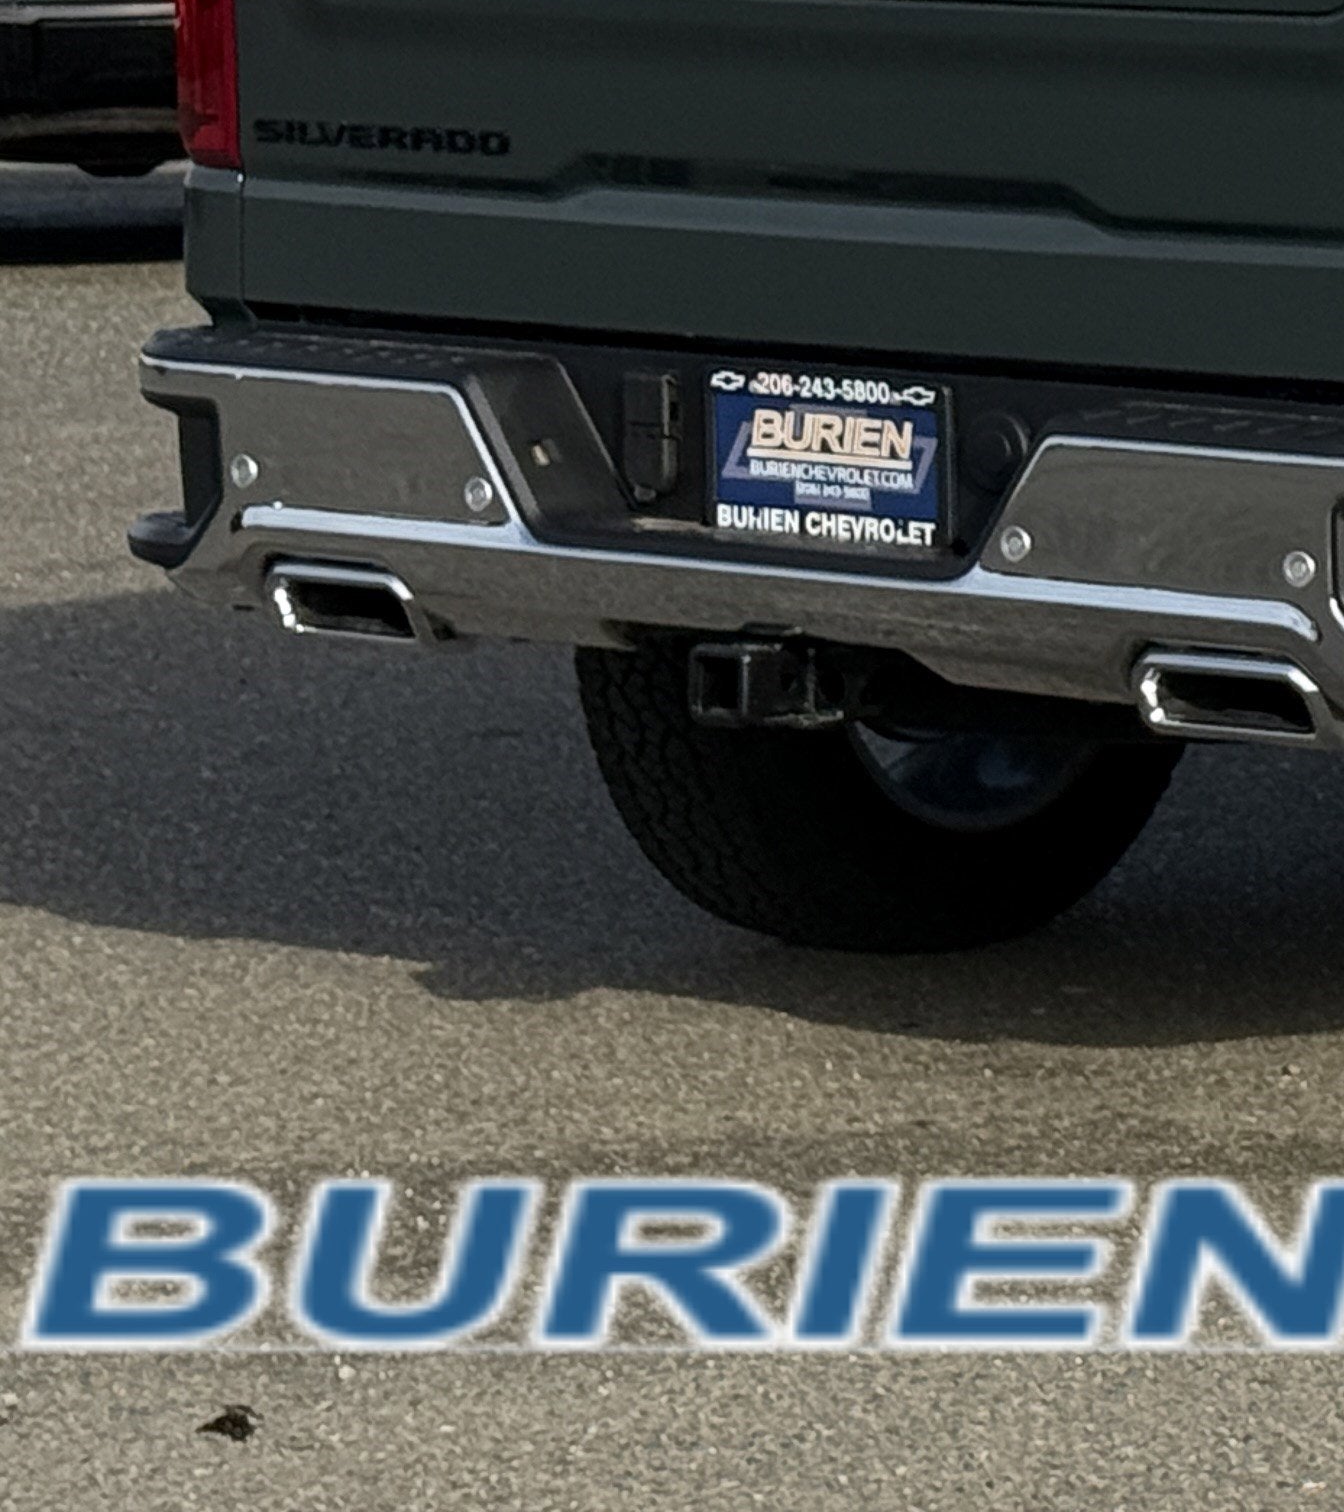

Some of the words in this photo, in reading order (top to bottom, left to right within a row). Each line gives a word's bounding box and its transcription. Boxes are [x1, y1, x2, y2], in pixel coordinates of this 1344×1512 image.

[253, 118, 511, 157] SILVERADO
[757, 371, 890, 405] 206-243-5800
[751, 409, 914, 460] BURIEN
[749, 459, 914, 489] BURIENCHEVROLET.COM
[717, 503, 800, 535] BURIEN
[805, 511, 937, 547] CHEVROLET
